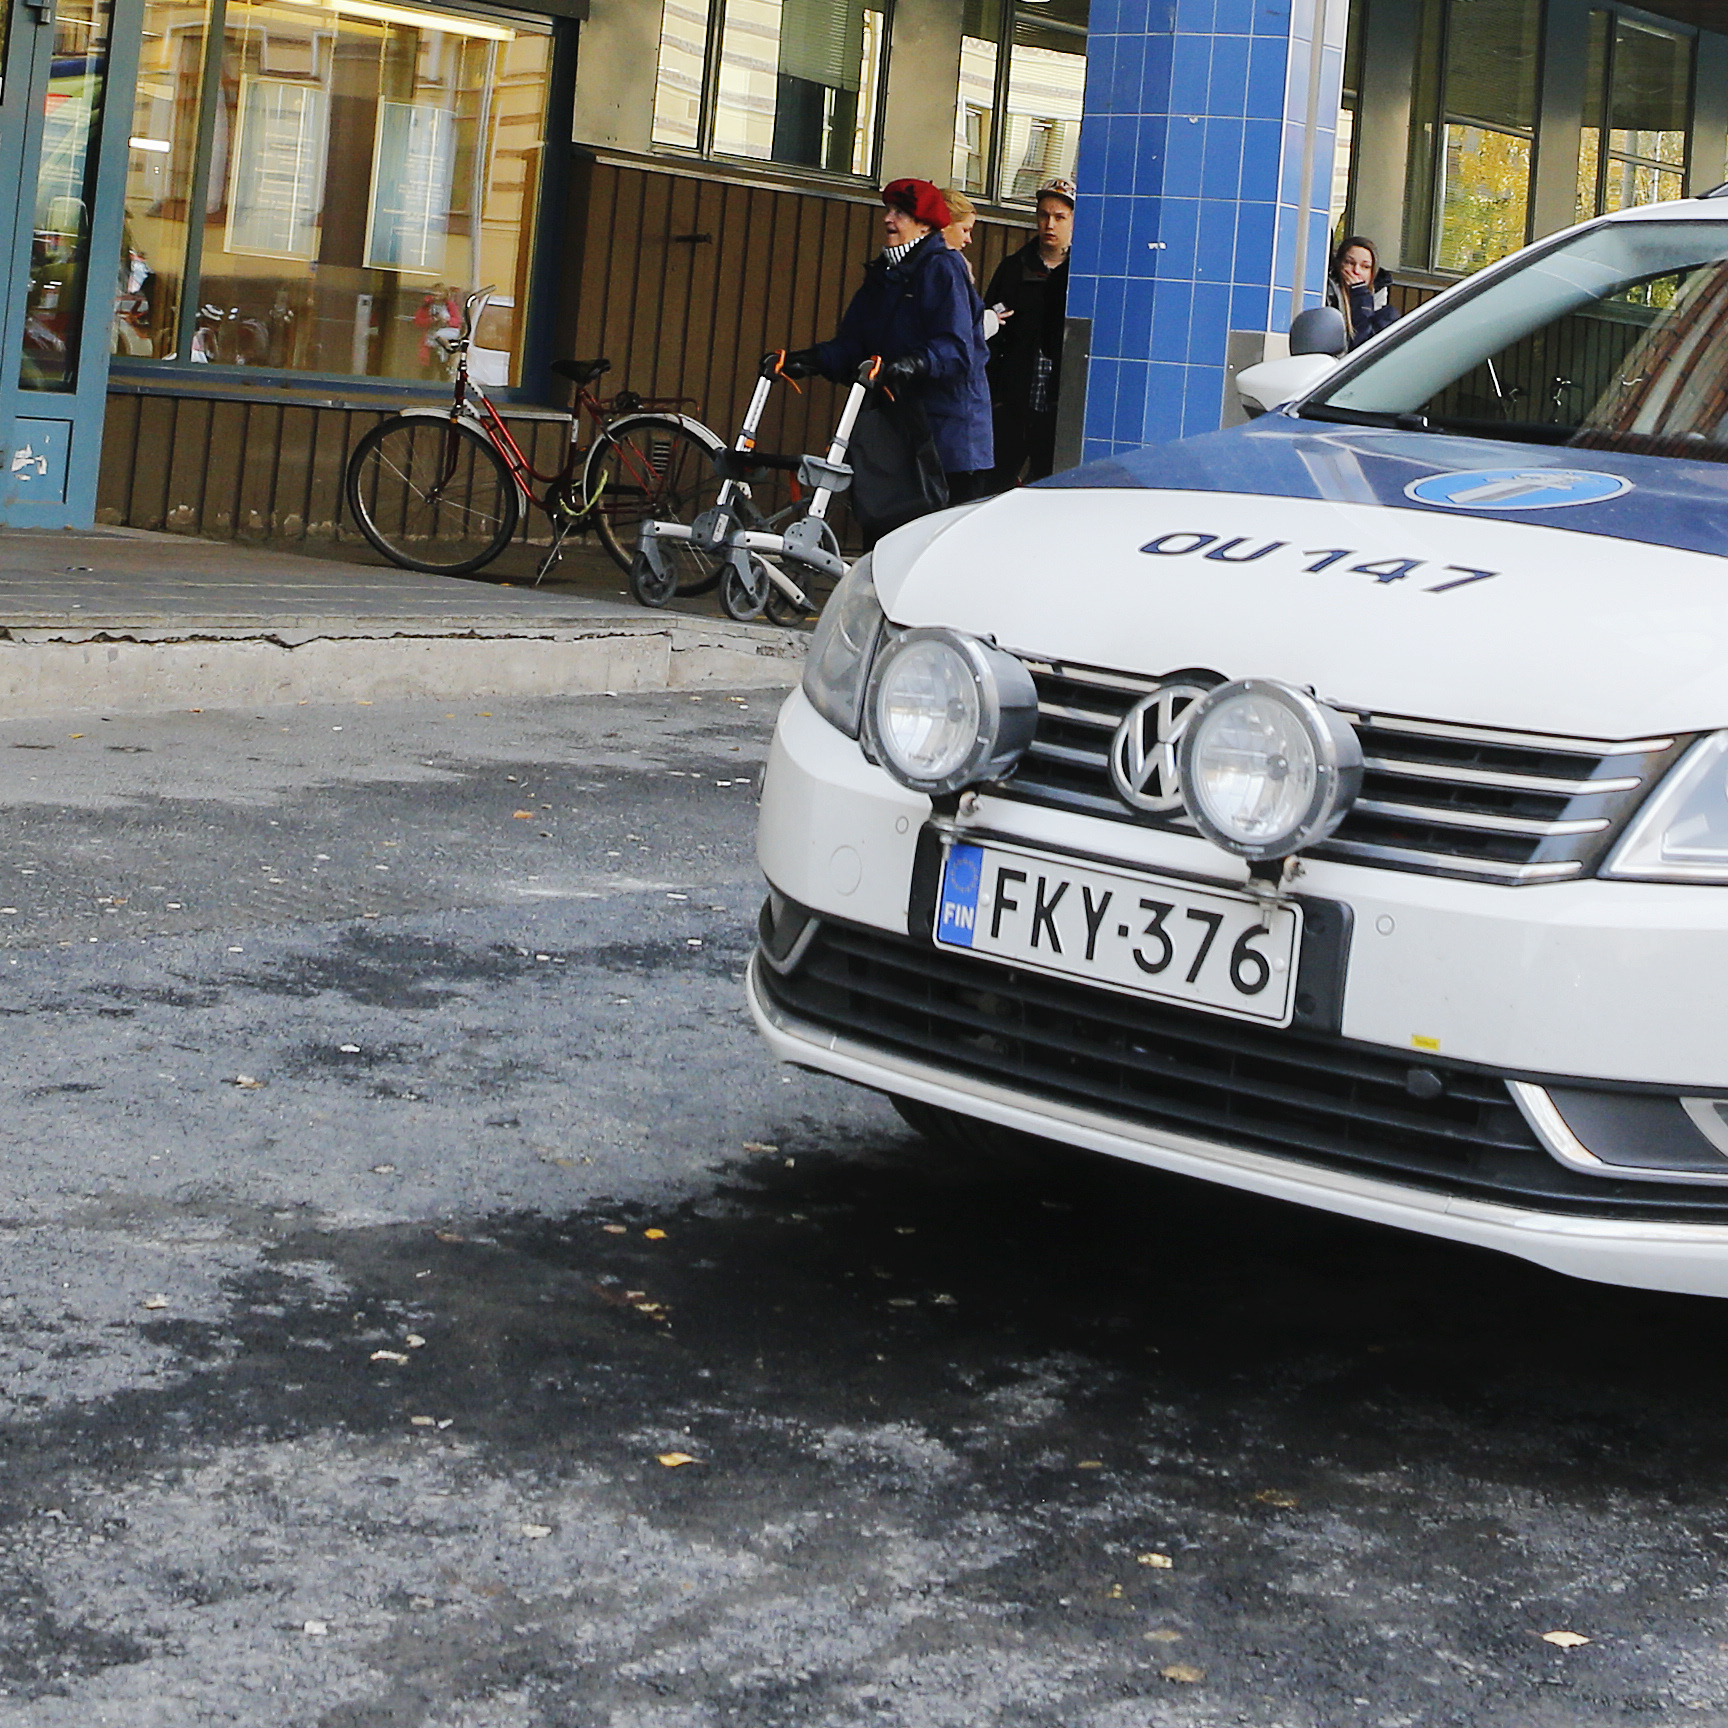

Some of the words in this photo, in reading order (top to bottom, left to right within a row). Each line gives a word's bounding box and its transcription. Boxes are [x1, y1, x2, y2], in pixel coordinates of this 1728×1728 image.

[1138, 532, 1291, 562] OU
[1302, 548, 1501, 593] 147
[944, 902, 973, 930] FIN
